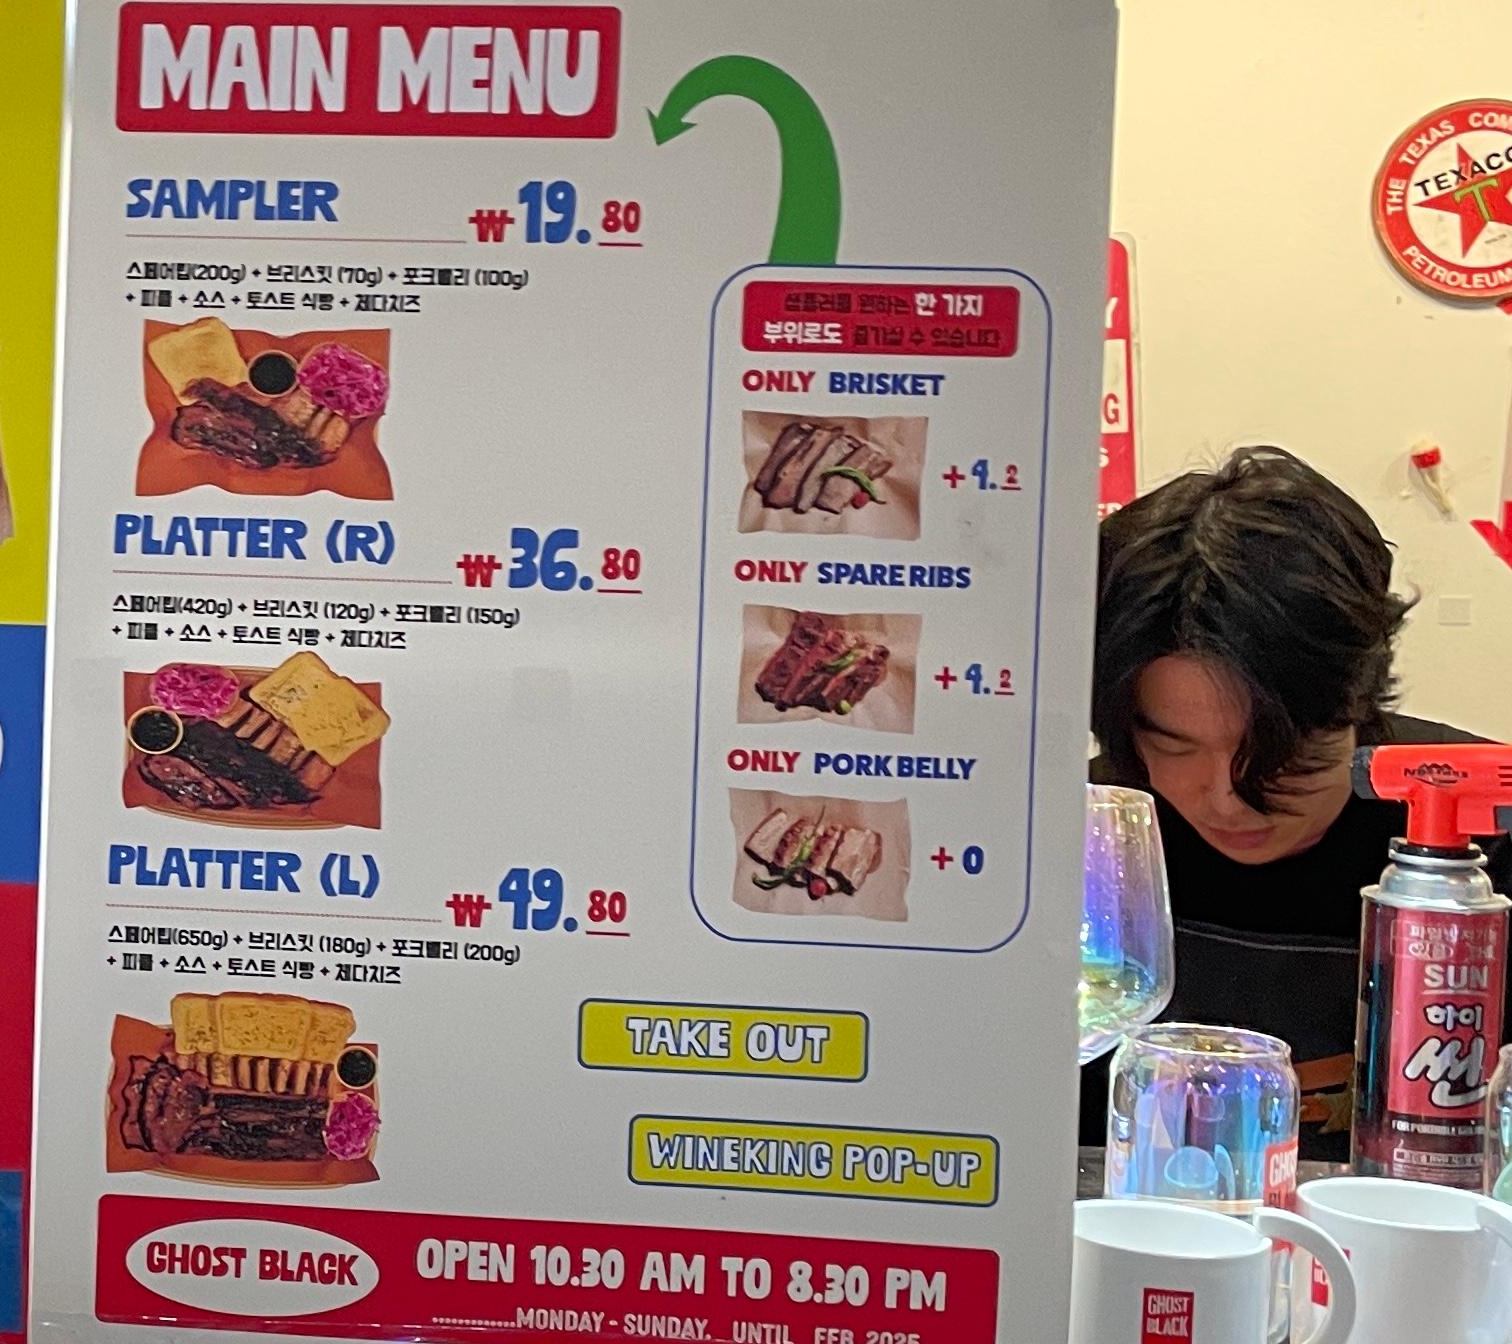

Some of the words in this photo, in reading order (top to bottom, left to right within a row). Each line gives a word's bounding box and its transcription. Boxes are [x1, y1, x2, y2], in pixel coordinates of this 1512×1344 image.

[138, 23, 348, 112] MAIN
[376, 24, 600, 117] MENU
[1386, 177, 1408, 216] THE
[1399, 119, 1457, 166] TEXAS
[125, 178, 340, 222] SAMPLER
[266, 263, 333, 284] 브리스킷
[338, 265, 383, 287] (70g)
[474, 268, 529, 290] (100g)
[193, 290, 226, 309] 소스
[246, 290, 296, 311] 토스트
[301, 291, 334, 311] 식빵
[914, 291, 937, 317] 한
[942, 293, 983, 317] 가지
[763, 320, 843, 345] 부위로도
[742, 369, 817, 393] ONLY
[828, 371, 946, 396] BRISKET
[113, 513, 308, 561] PLATTER
[325, 519, 396, 565] (R)
[734, 558, 809, 584] ONLY
[817, 561, 906, 587] SPARE
[909, 564, 972, 590] RIBS
[253, 598, 319, 621] 브리스킷
[323, 601, 374, 624] (120g)
[467, 606, 520, 629] (150g)
[179, 623, 212, 643] 소스
[232, 625, 282, 646] 토스트
[287, 626, 319, 647] 식빵
[727, 748, 802, 773] ONLY
[813, 752, 894, 777] PORK
[897, 755, 977, 781] BELLY
[107, 843, 302, 893] PLATTER
[319, 852, 380, 899] (L)
[248, 930, 314, 954] 브리스킷
[318, 934, 372, 957] (180g)
[463, 941, 521, 965] (200g)
[174, 955, 207, 975] 소스
[227, 957, 277, 979] 토스트
[282, 959, 315, 981] 식빵
[1423, 964, 1489, 990] SUN
[1424, 1004, 1483, 1033] 하이
[625, 1016, 732, 1059] TAKE
[746, 1021, 830, 1064] OUT
[648, 1132, 833, 1179] WINEKING
[842, 1143, 982, 1189] POP-UP
[145, 1239, 248, 1279] GHOST
[258, 1248, 360, 1287] BLACK
[416, 1237, 516, 1284] OPEN
[529, 1245, 626, 1290] 10.30
[639, 1251, 706, 1295] AM
[720, 1255, 773, 1300] TO
[786, 1260, 871, 1307] 8.30
[883, 1267, 948, 1312] PM
[1147, 1294, 1190, 1316] GHOST
[1146, 1316, 1189, 1338] BLACK
